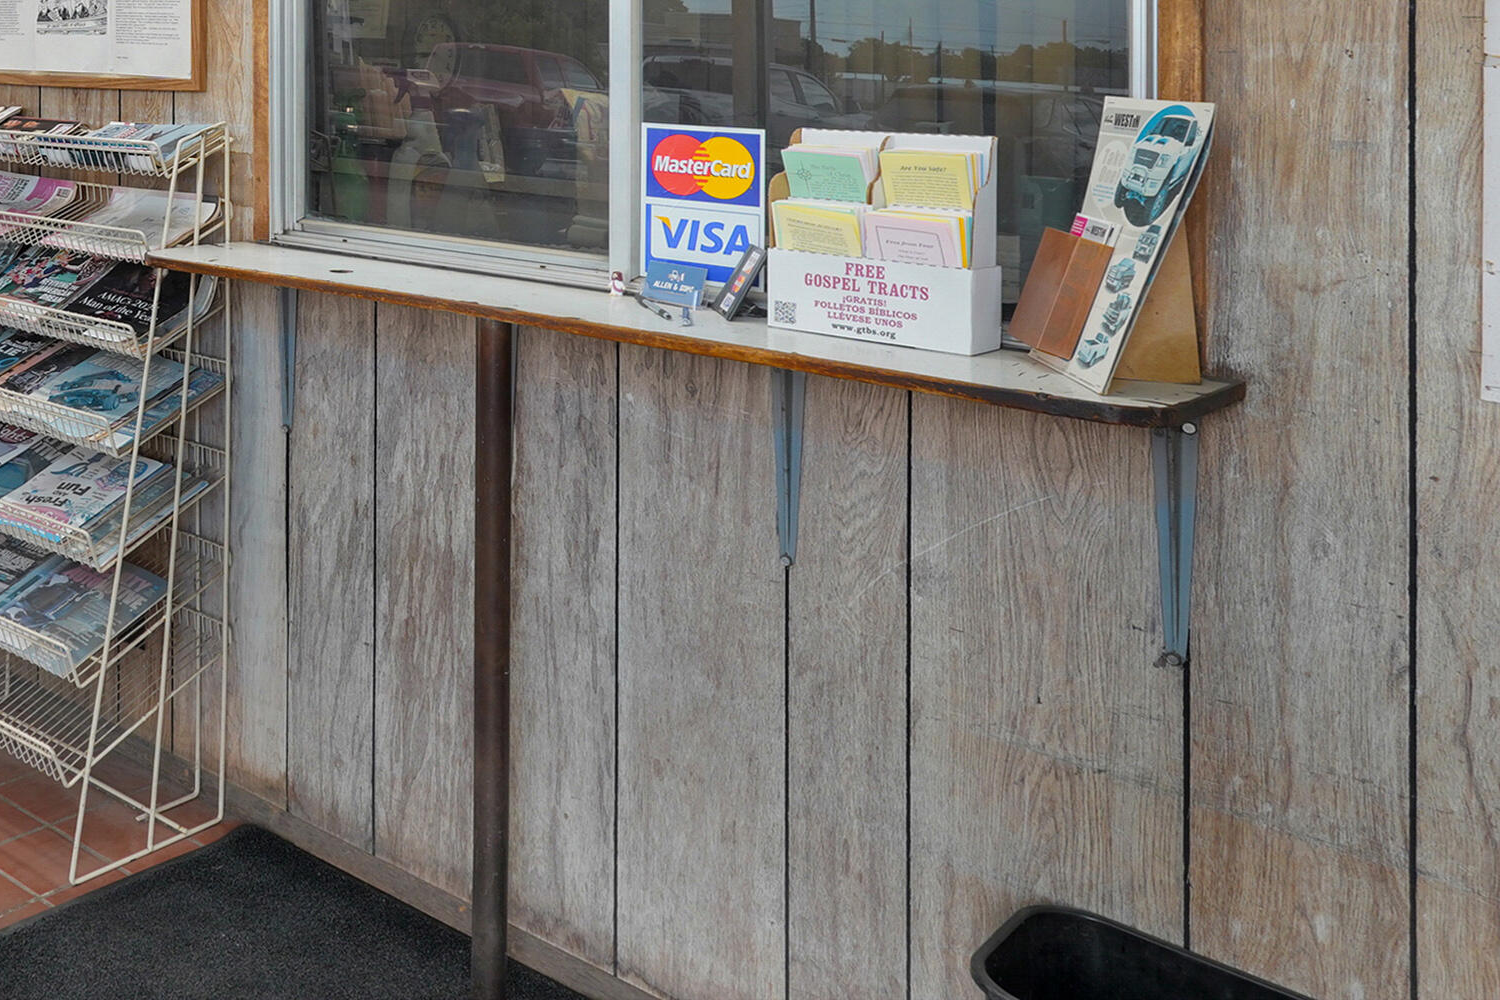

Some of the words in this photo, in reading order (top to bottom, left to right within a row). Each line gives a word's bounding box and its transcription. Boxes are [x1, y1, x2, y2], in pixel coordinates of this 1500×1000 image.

[654, 155, 752, 179] MasterCard
[654, 215, 751, 256] VISA
[845, 262, 885, 280] FREE
[804, 273, 860, 293] GOSPEL
[868, 280, 929, 301] TRACTS
[79, 296, 103, 310] Man
[104, 302, 118, 313] of
[118, 304, 133, 316] the
[134, 310, 157, 322] Yea
[814, 300, 867, 314] FOLLETOS
[869, 304, 918, 321] BÍBLICOS
[831, 322, 896, 340] www.gtbs.org
[875, 318, 904, 329] UNOS
[56, 482, 91, 496] Fun
